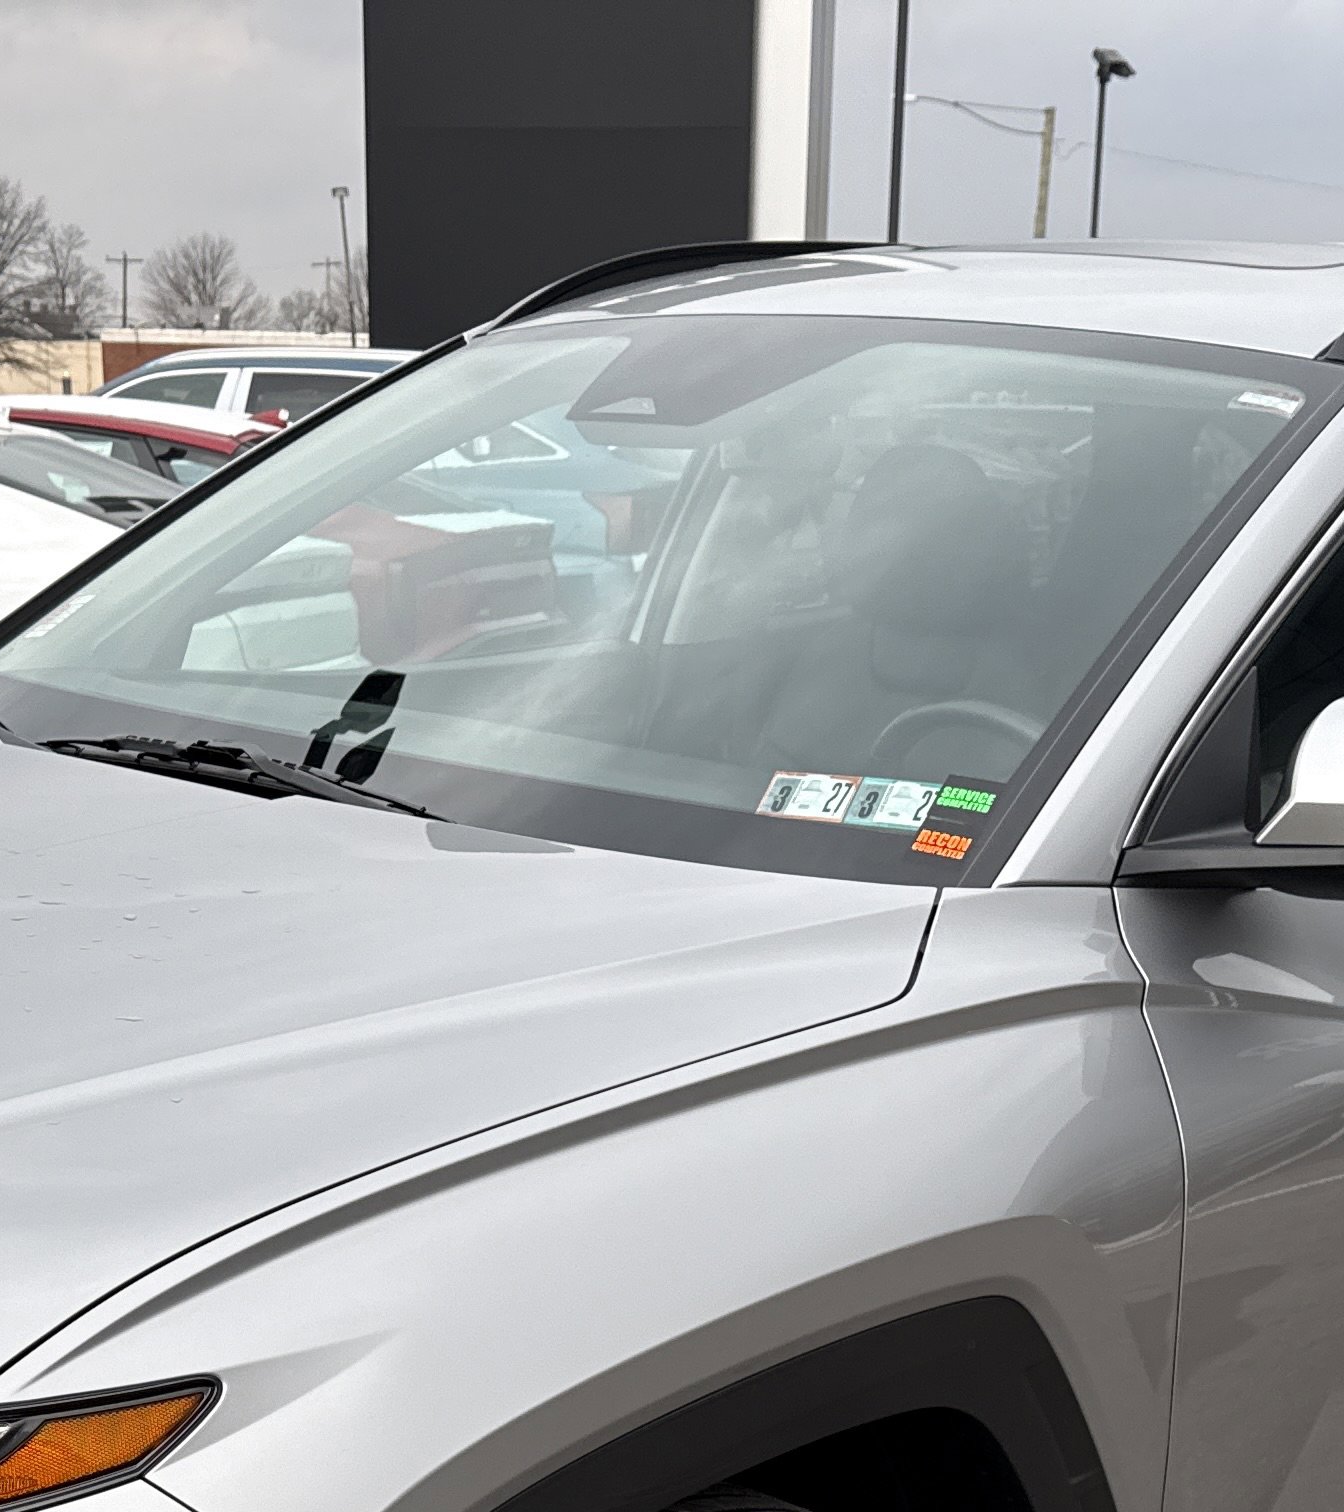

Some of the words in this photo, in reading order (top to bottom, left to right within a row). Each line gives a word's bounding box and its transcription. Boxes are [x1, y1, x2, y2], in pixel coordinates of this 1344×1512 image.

[770, 785, 793, 812] 3
[822, 782, 854, 814] 27
[858, 791, 880, 819] 3
[912, 790, 940, 821] 2
[936, 796, 991, 814] COMPLETED
[941, 786, 997, 806] SERVICE
[911, 841, 966, 860] COMPLETED
[916, 829, 973, 852] RECON
